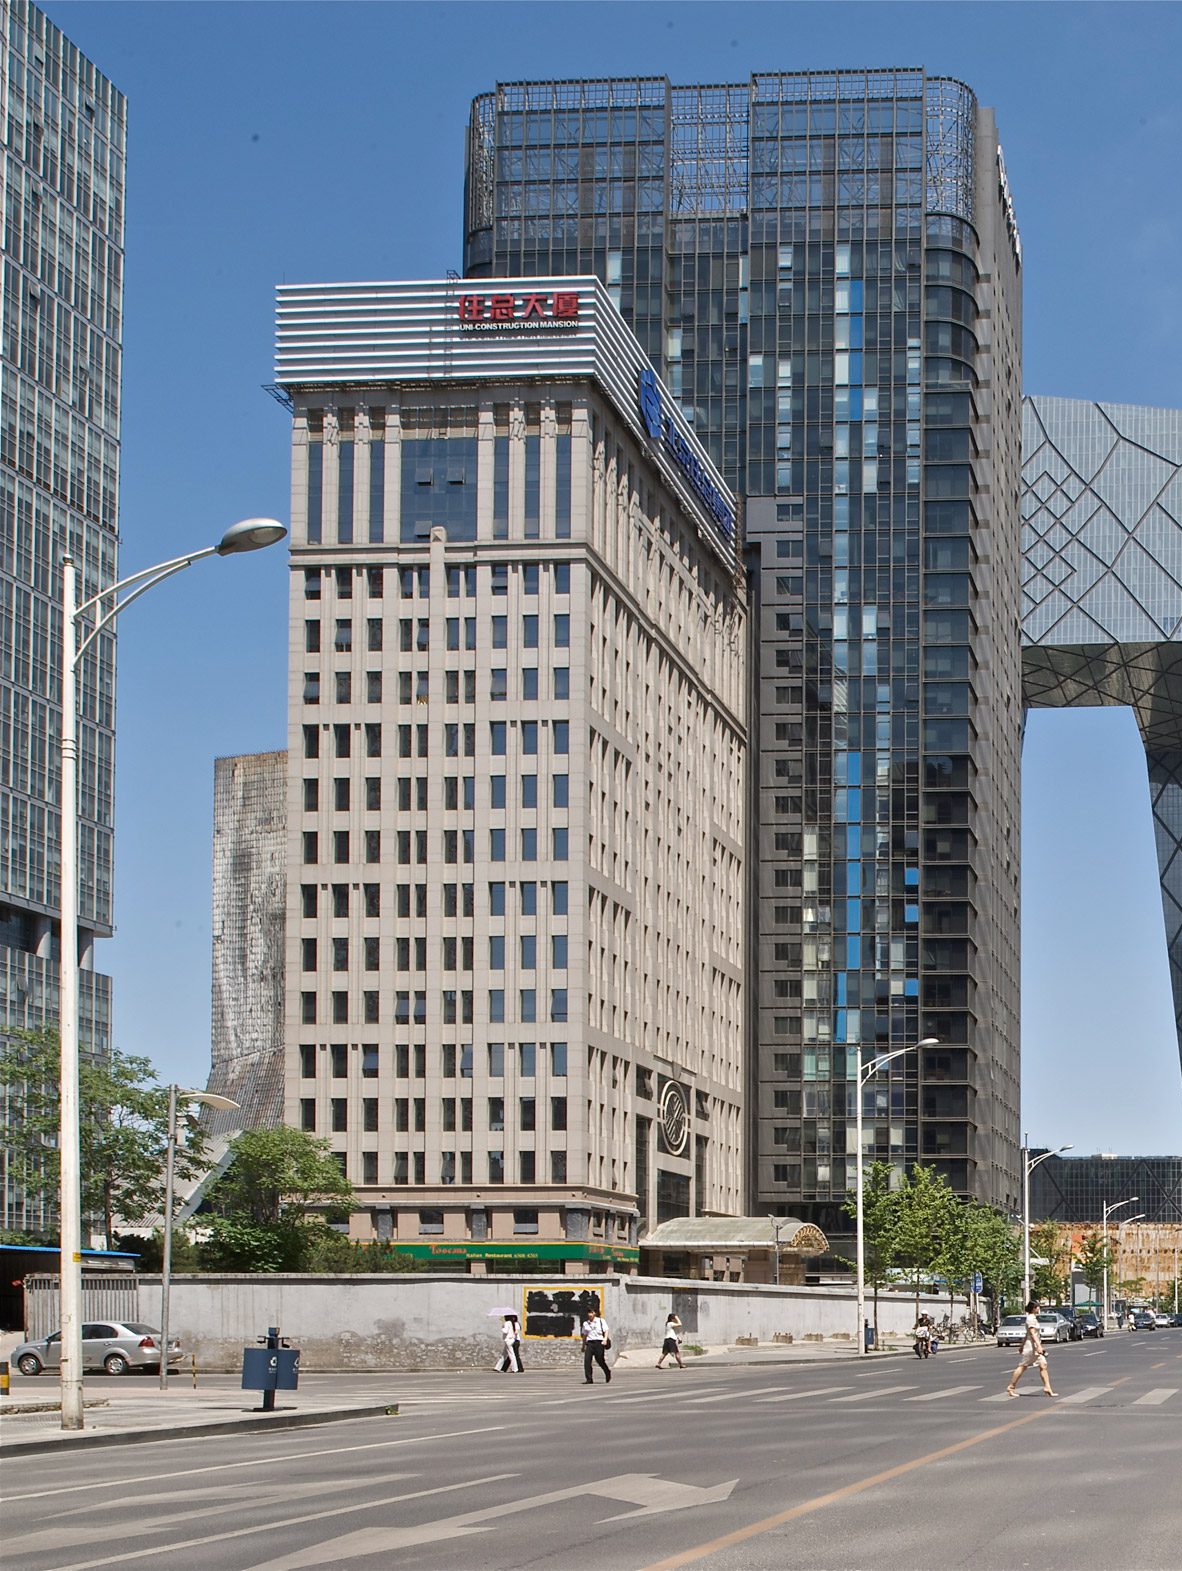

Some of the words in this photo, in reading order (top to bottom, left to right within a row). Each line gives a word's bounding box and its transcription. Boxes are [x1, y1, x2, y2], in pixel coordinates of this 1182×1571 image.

[459, 292, 579, 320] 住总大厦
[460, 322, 539, 331] UNI-CONSTRUCTION
[540, 320, 579, 329] MANSION
